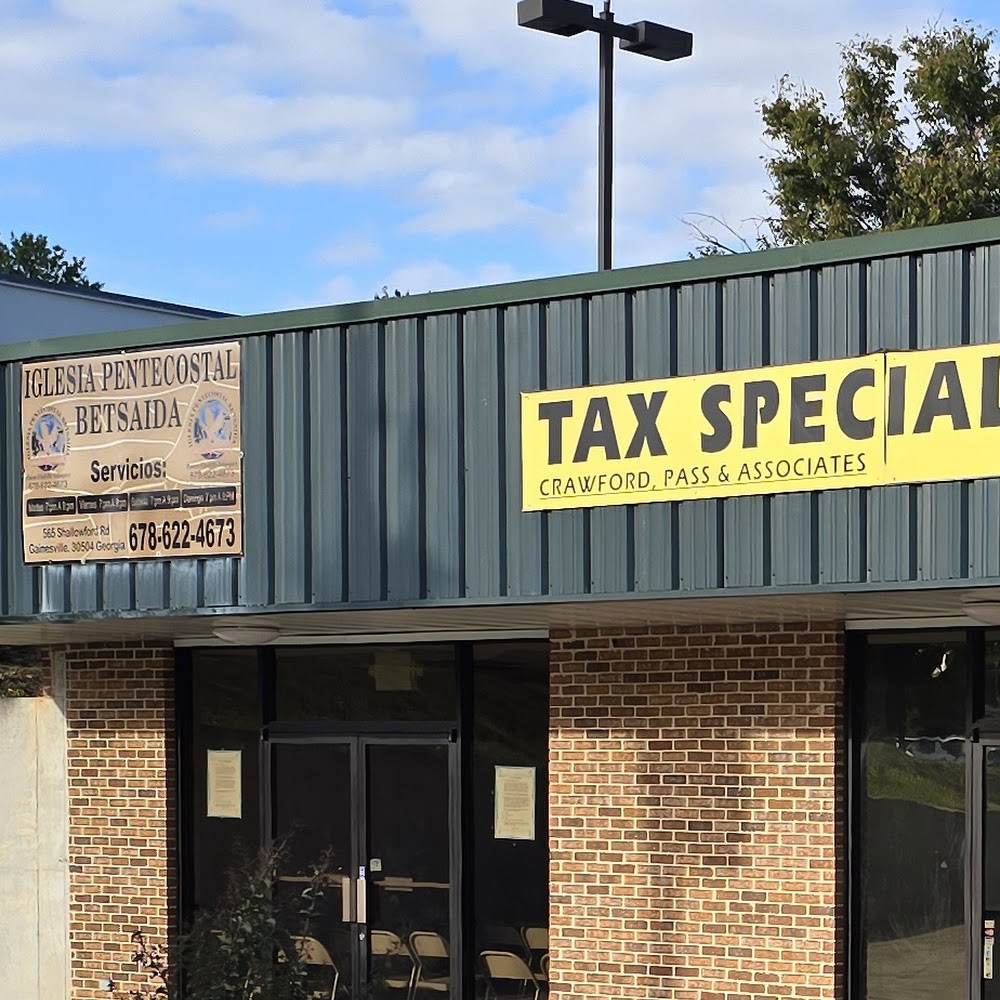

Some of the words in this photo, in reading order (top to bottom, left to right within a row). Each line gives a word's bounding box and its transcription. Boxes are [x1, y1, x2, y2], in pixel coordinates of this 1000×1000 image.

[24, 362, 96, 399] IGLESIA
[101, 349, 237, 392] PENTECOSTAL
[75, 397, 182, 436] BETSAIDA
[538, 389, 667, 466] TAX
[90, 457, 167, 483] Servicios:
[540, 471, 656, 496] CRAWFORD,
[664, 466, 710, 487] PASS
[718, 464, 730, 482] &
[738, 453, 866, 481] ASSOCIATES
[100, 525, 110, 536] Rd
[129, 517, 236, 551] 678-622-4673
